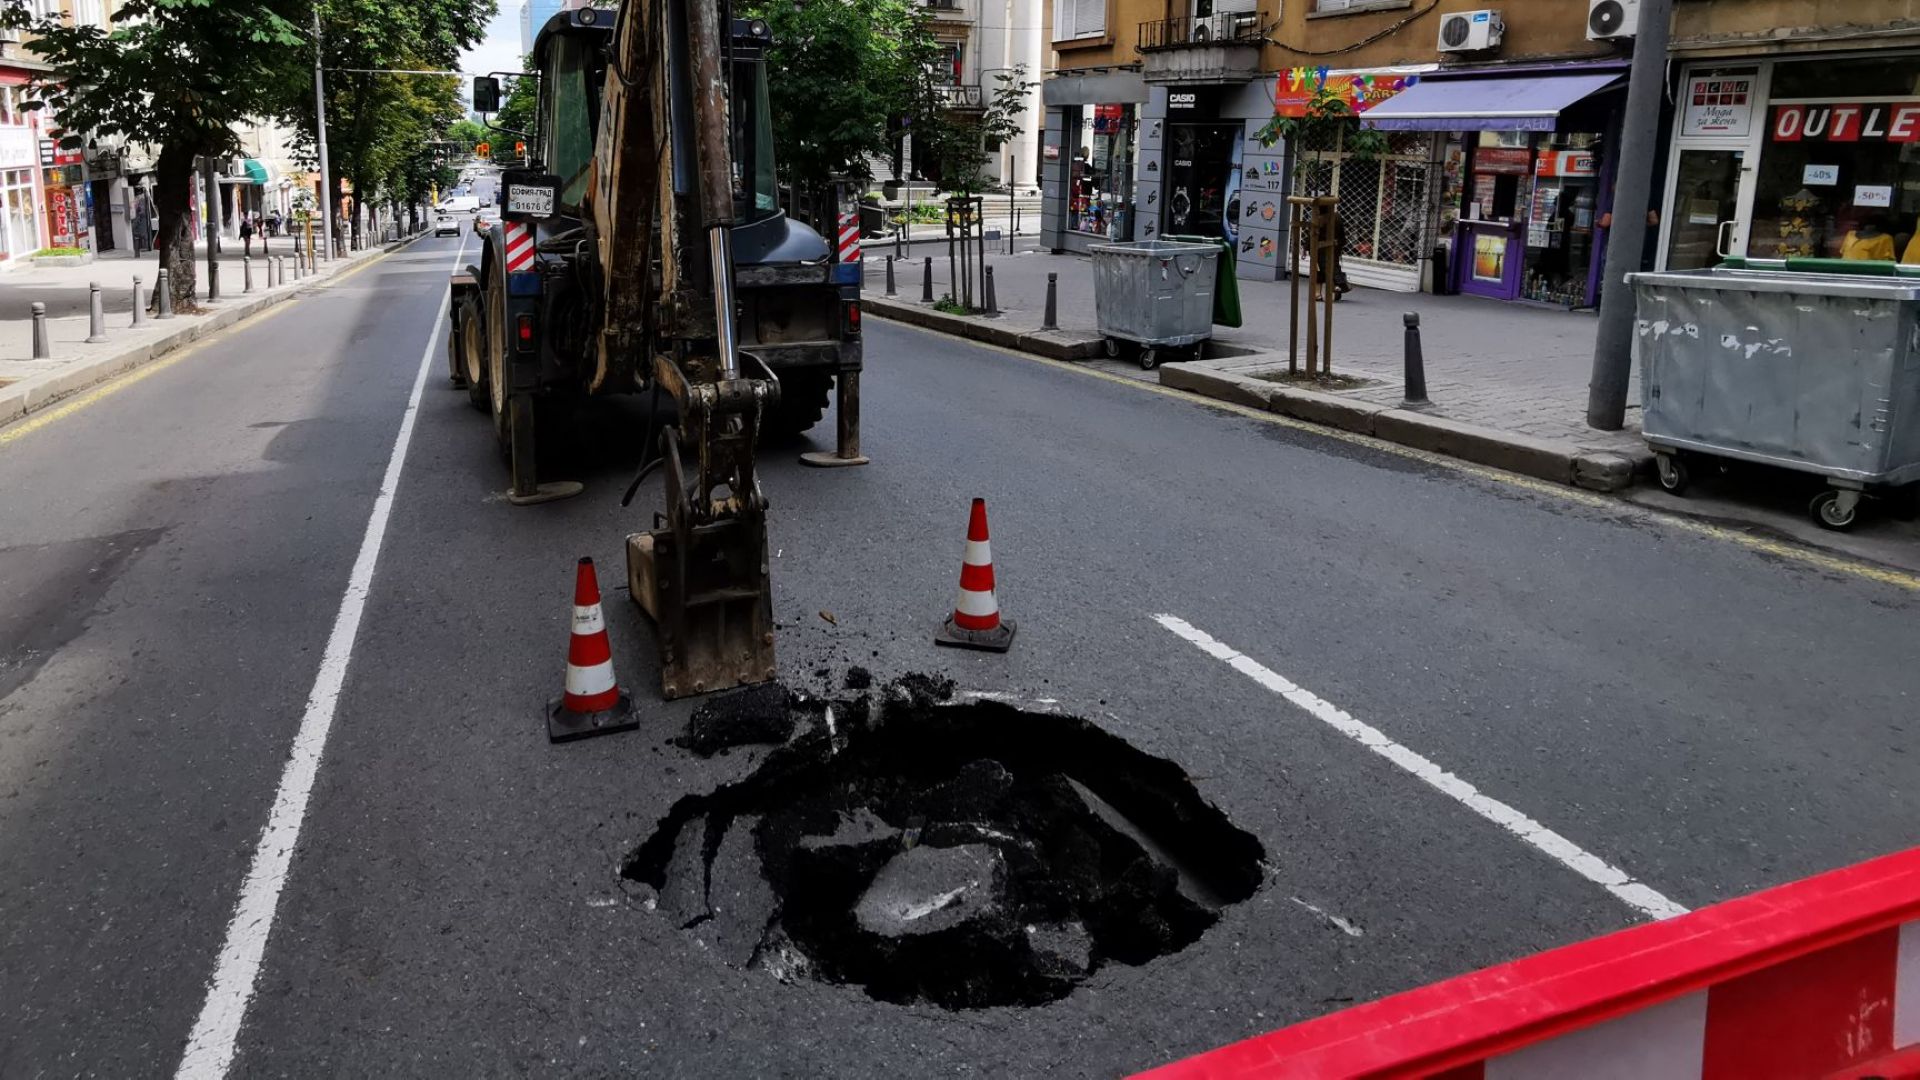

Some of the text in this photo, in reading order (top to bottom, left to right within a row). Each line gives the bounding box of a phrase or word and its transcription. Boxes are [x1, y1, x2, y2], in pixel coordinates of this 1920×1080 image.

[1169, 94, 1195, 102] CASIO
[1777, 108, 1920, 137] OUTLE
[1267, 181, 1280, 190] 117
[516, 202, 541, 211] 01676
[55, 195, 68, 236] ФОТО
